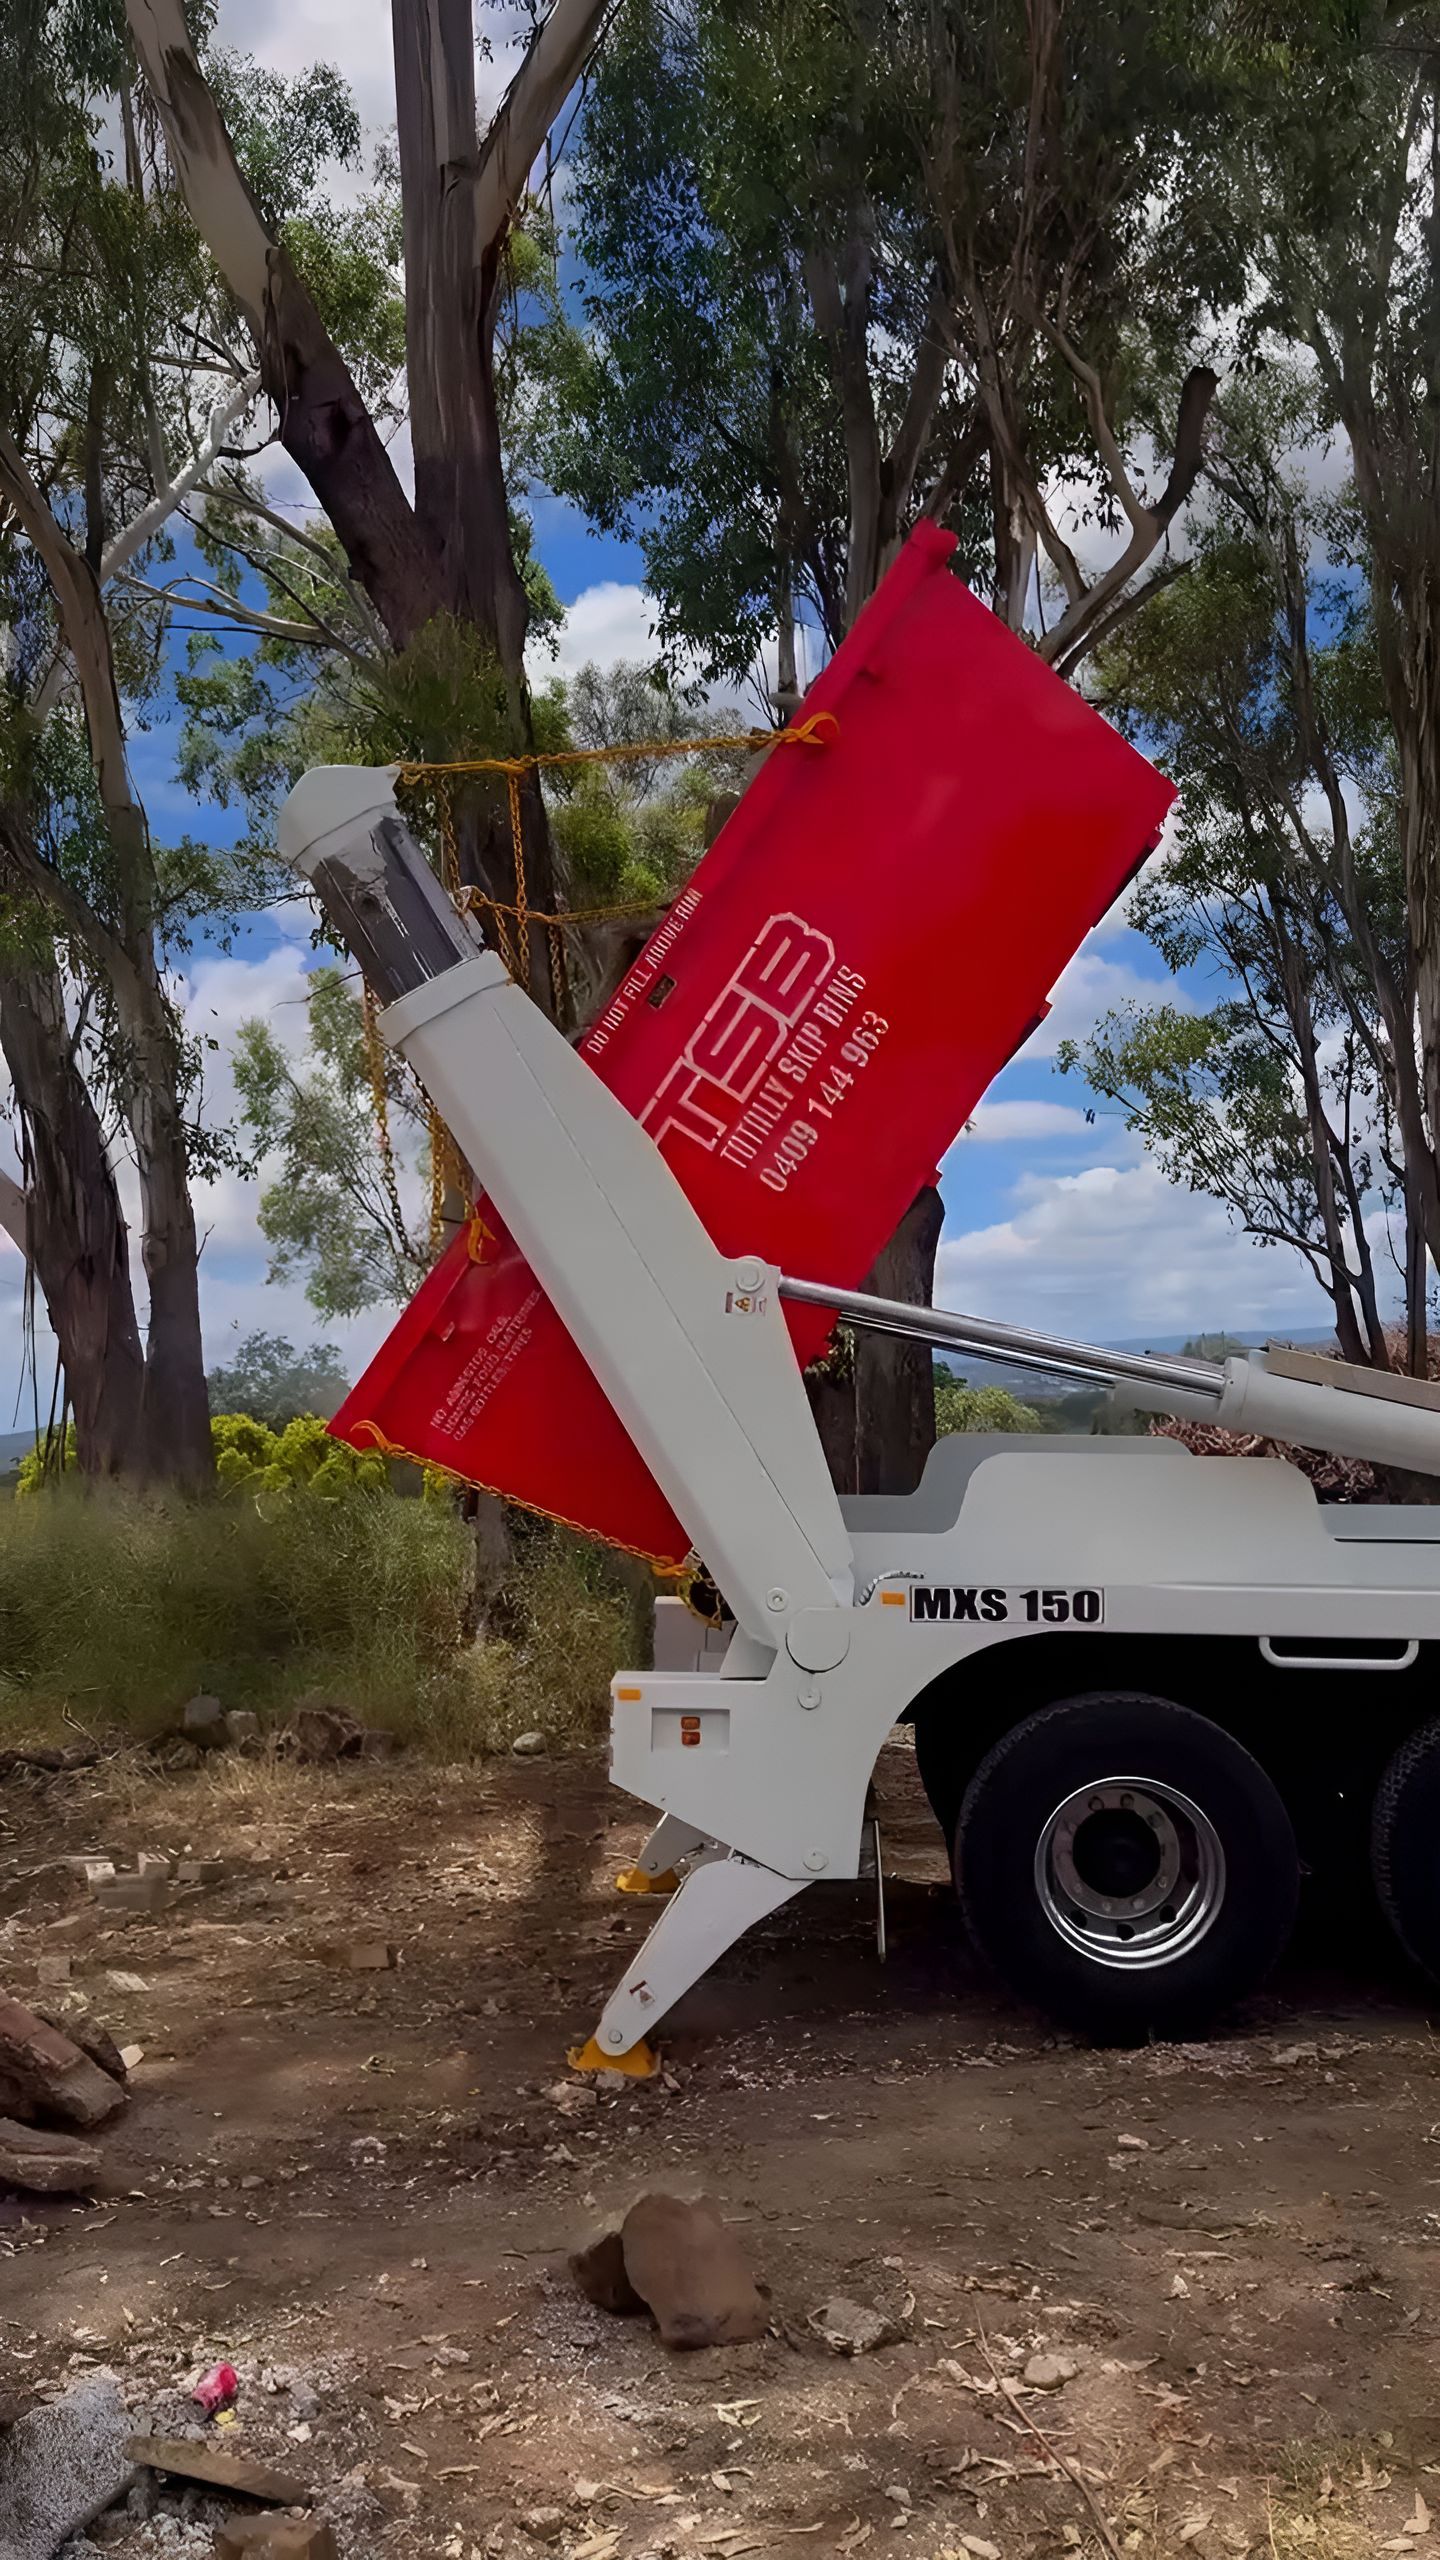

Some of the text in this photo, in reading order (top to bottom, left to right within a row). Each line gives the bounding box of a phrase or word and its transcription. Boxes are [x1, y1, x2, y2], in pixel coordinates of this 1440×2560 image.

[587, 1029, 609, 1054] DO
[602, 998, 629, 1030] NOT
[623, 969, 652, 1000] FILL
[644, 916, 684, 970] ABOVE
[636, 911, 836, 1152] TSB
[720, 965, 867, 1168] TOTALLY SKIP BINS
[760, 1010, 889, 1192] 0409 144 963
[913, 1588, 1100, 1622] MXS 150
